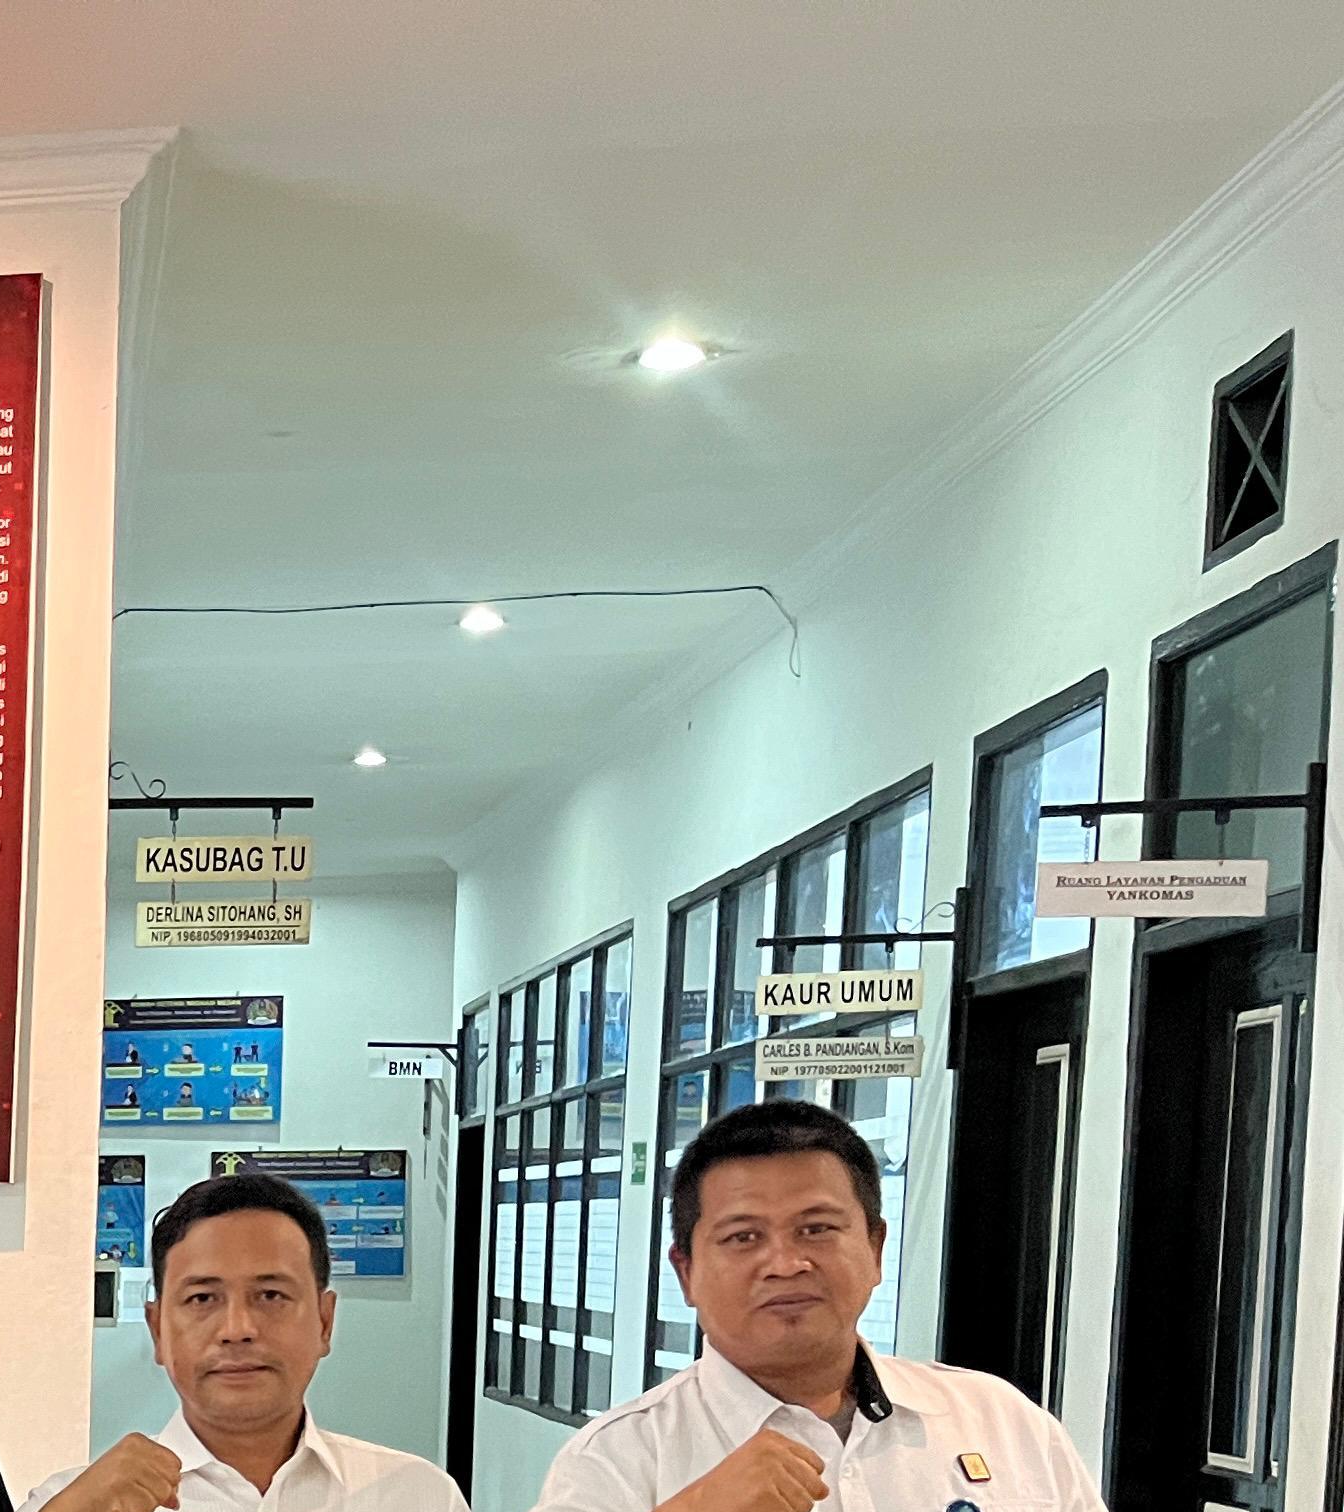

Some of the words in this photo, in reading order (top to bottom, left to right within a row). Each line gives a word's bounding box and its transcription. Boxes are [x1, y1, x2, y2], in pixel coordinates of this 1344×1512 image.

[146, 847, 263, 872] KASUBAG
[272, 847, 306, 871] T.U
[1108, 889, 1194, 900] YANKOMAS
[147, 906, 203, 922] DERLINA
[208, 905, 280, 923] SITOHANG,
[284, 905, 302, 920] SH
[177, 929, 296, 941] 196805091994032001
[764, 982, 831, 1005] KAUR
[841, 979, 913, 1003] UMUM
[763, 1044, 801, 1057] CARLES
[804, 1043, 812, 1056] B.
[885, 1042, 914, 1055] S.Kom
[389, 1061, 422, 1075] BMN
